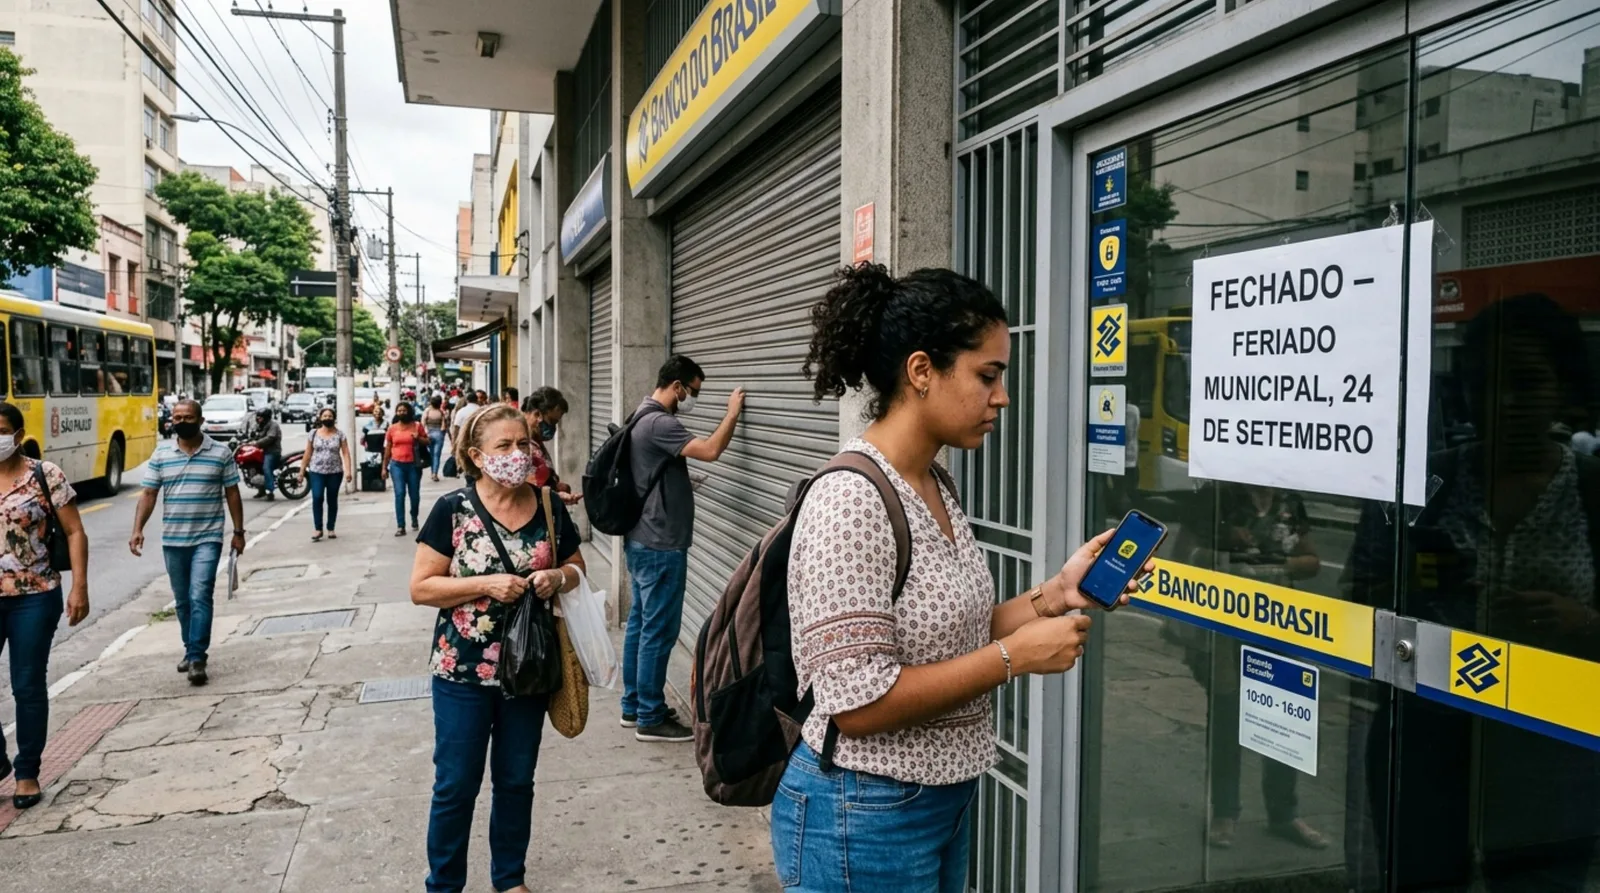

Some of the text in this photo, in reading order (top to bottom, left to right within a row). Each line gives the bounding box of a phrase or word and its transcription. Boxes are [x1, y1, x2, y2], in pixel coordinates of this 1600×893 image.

[651, 61, 688, 145] BANCO
[690, 34, 709, 100] DO
[1210, 264, 1344, 311] FECHADO
[1232, 325, 1336, 357] FERIADO
[1204, 373, 1374, 407] MUNICIPAL, 24
[1203, 418, 1374, 454] DE SETEMBRO
[1158, 568, 1334, 643] BANCO DO BRASIL
[1246, 688, 1273, 708] 10:00
[1281, 700, 1311, 722] 16:00
